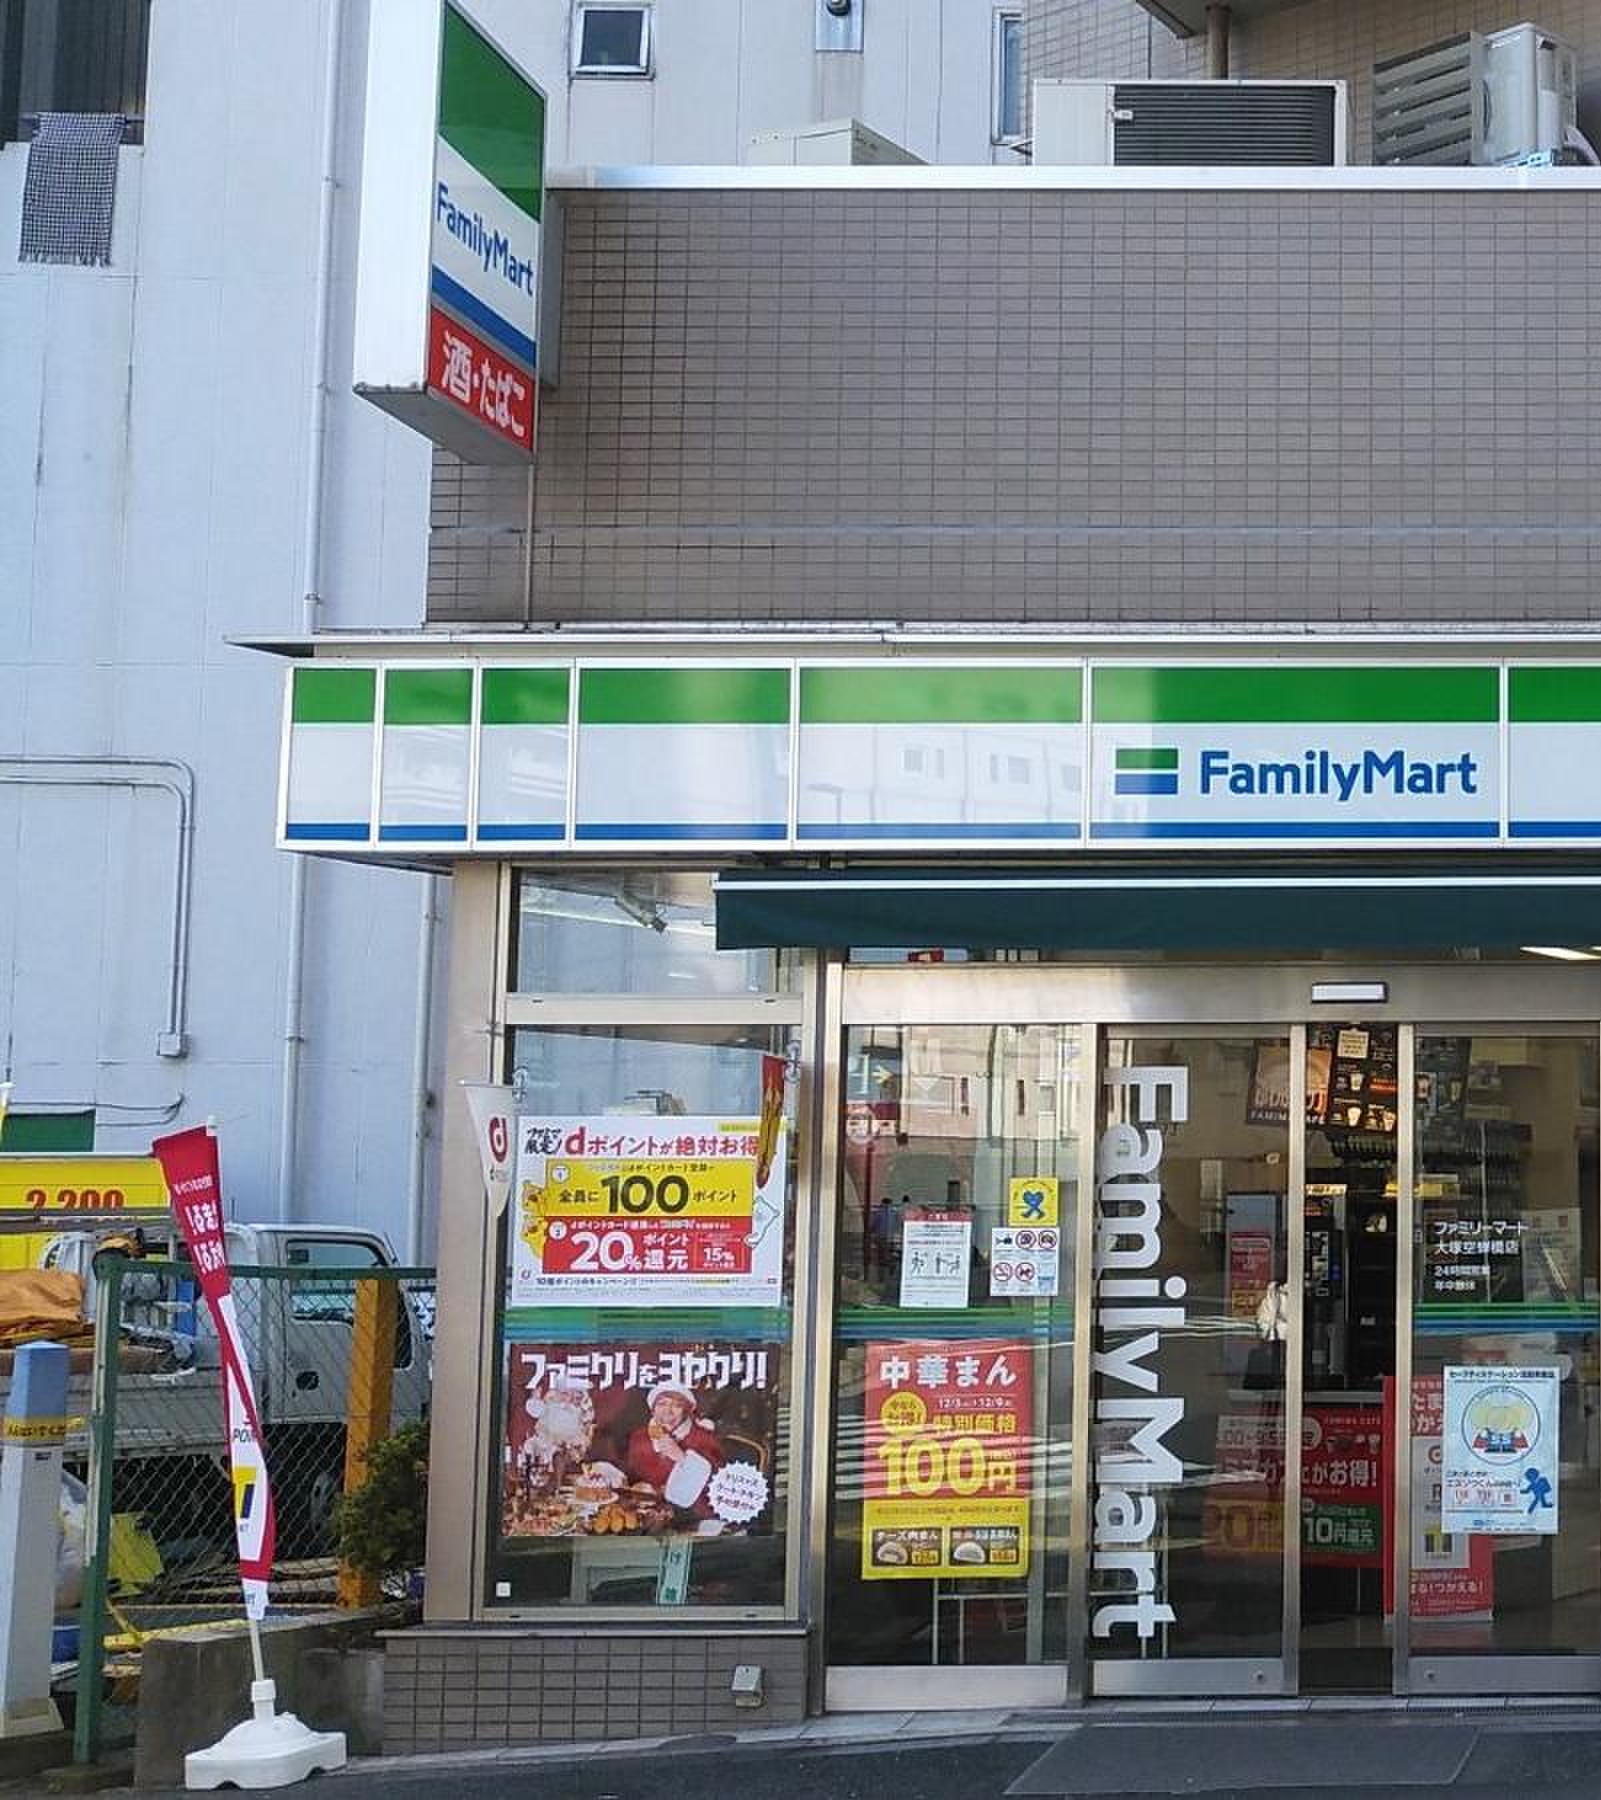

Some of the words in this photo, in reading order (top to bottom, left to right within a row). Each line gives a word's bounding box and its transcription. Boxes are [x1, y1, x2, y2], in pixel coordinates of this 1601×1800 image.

[437, 181, 534, 297] FamilyMart
[440, 329, 526, 438] 酒・たばこ
[1199, 750, 1479, 802] FamilyMart
[1434, 1221, 1530, 1237] ファミリーマート
[879, 1355, 1018, 1389] 中華まん
[1092, 1064, 1190, 1639] FamilyMart
